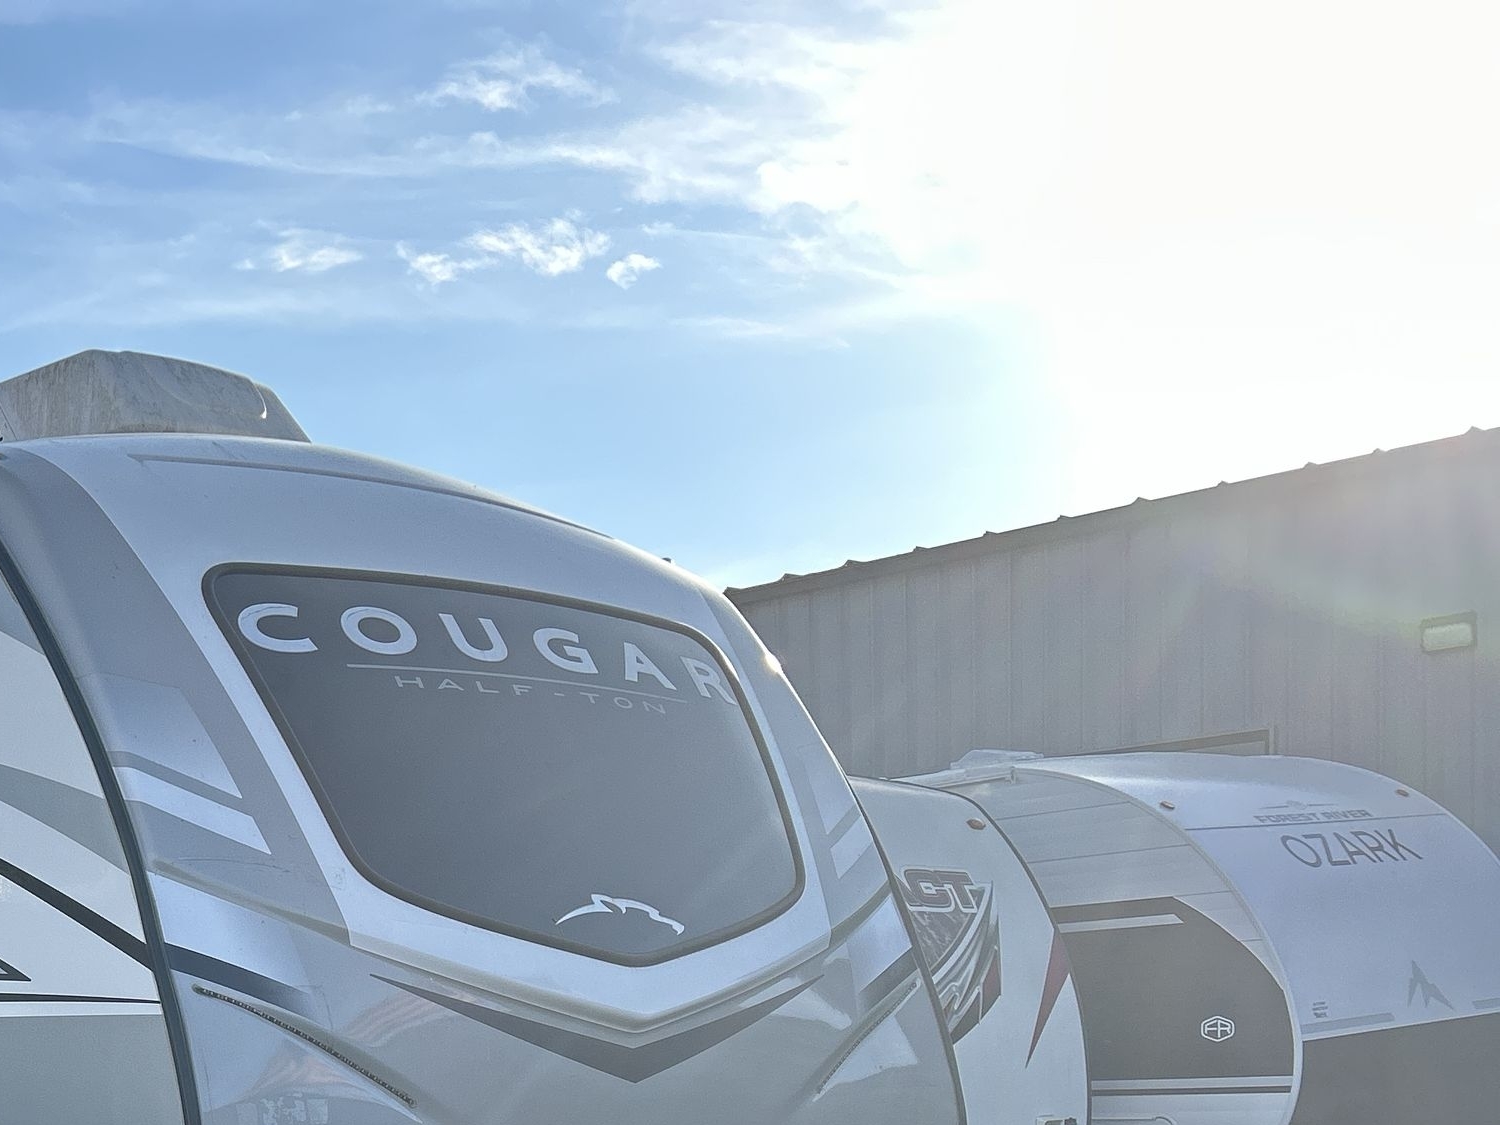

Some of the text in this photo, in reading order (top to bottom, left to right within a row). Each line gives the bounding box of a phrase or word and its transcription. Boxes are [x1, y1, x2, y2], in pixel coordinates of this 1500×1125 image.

[237, 602, 738, 706] COUGAR
[1253, 809, 1374, 824] FOREST RIVER
[1280, 828, 1423, 868] OZARK
